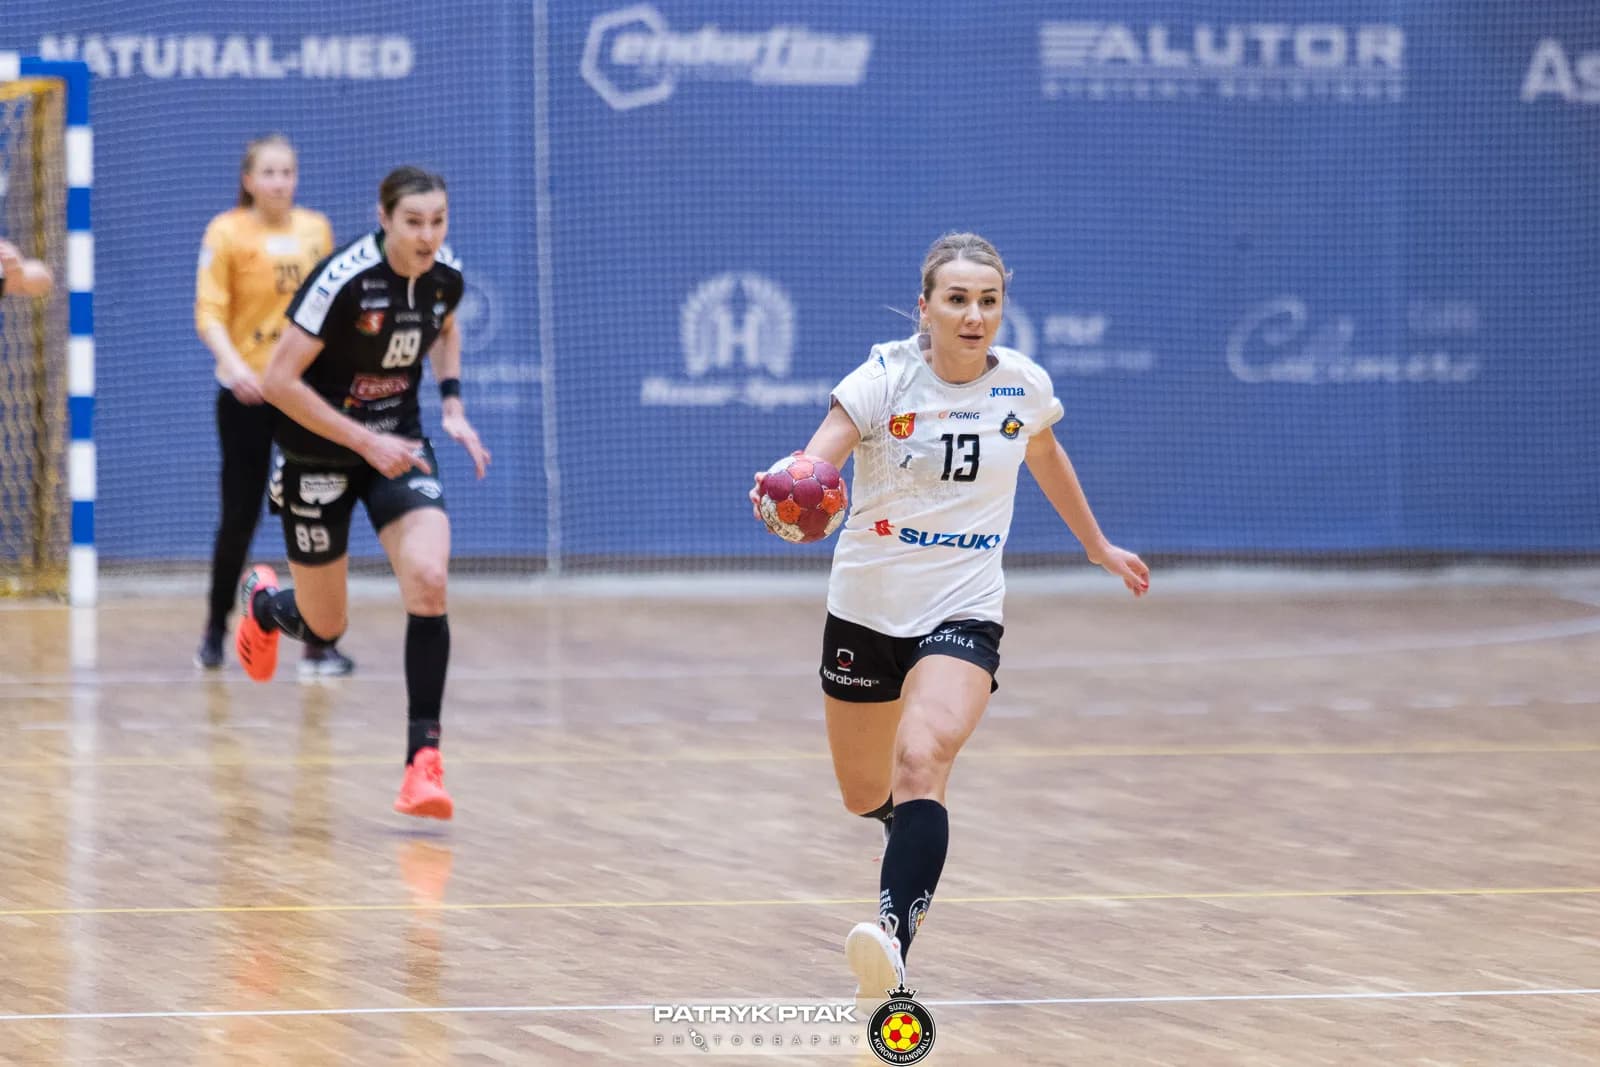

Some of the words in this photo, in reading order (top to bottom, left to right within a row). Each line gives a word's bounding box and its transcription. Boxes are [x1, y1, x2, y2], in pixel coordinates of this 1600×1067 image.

[40, 34, 414, 79] NATURAL-MED
[1094, 25, 1405, 67] ALUTOR
[381, 329, 422, 369] 89
[891, 421, 909, 437] CK
[940, 433, 980, 482] 13
[295, 523, 331, 553] 89
